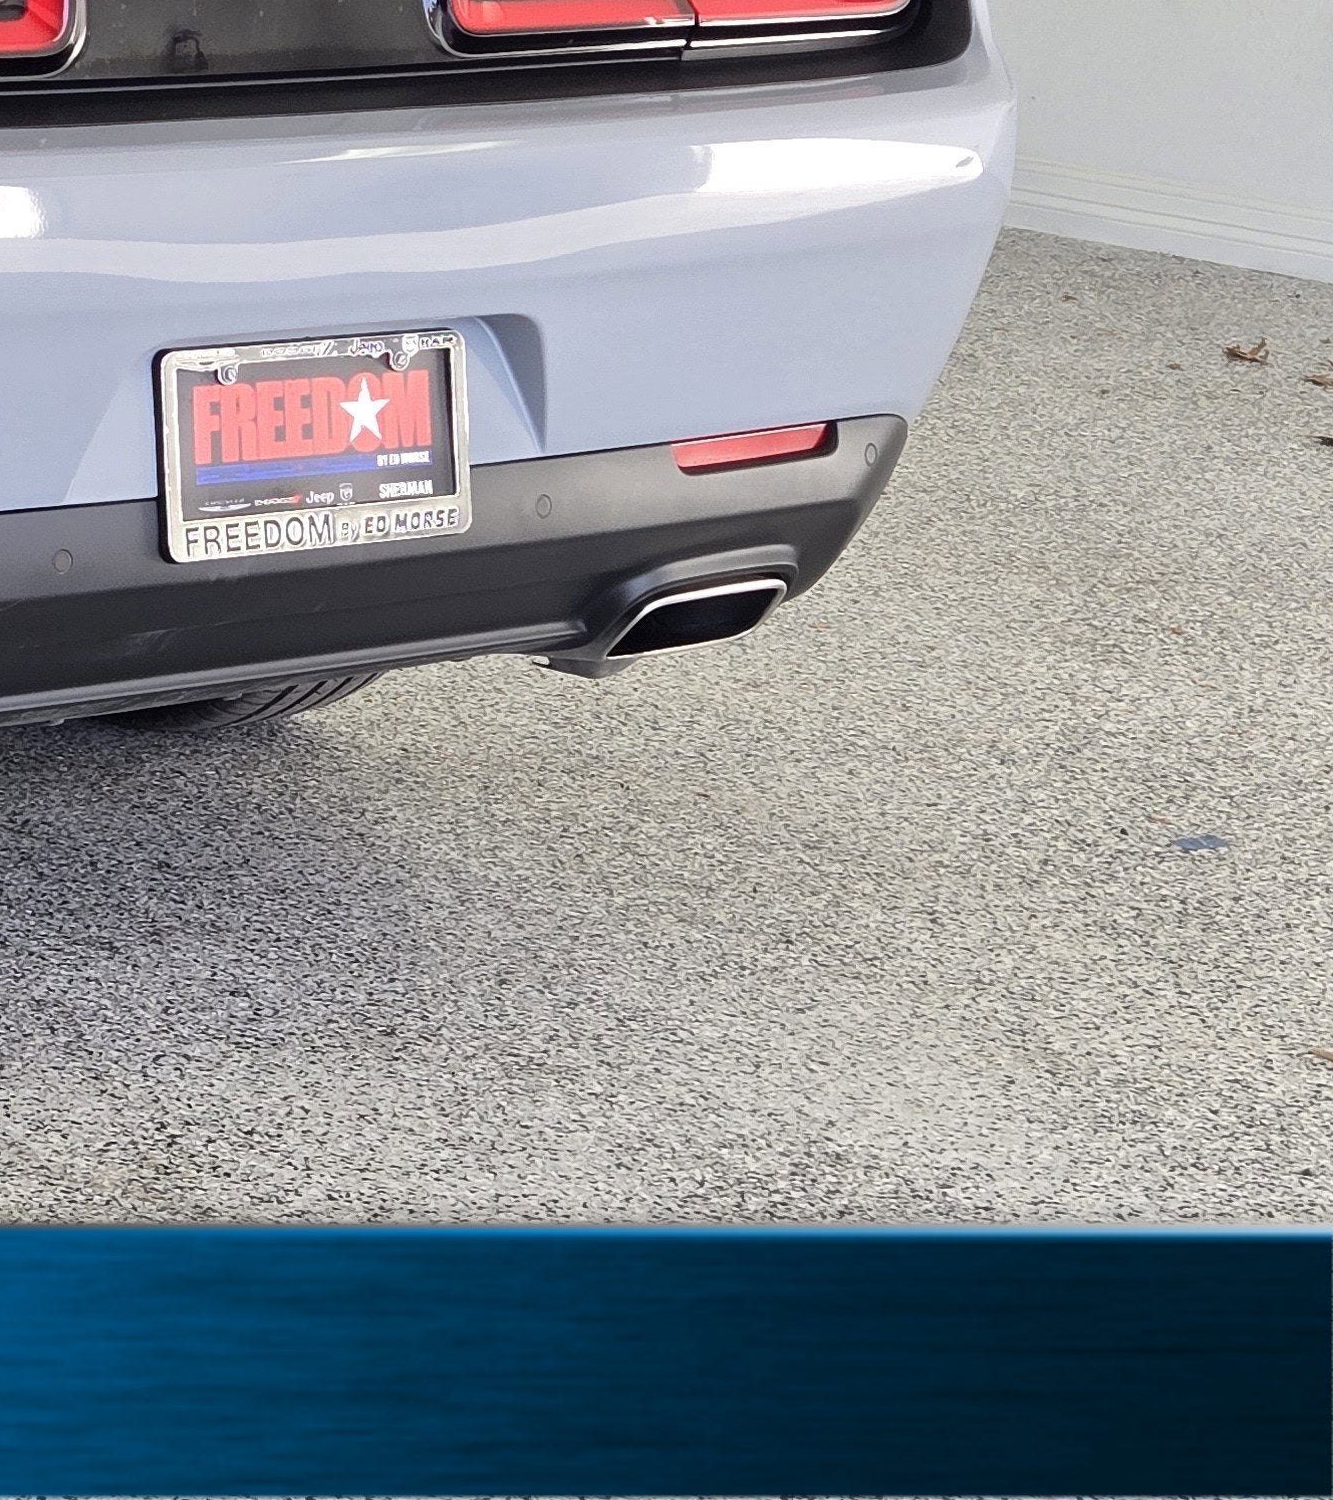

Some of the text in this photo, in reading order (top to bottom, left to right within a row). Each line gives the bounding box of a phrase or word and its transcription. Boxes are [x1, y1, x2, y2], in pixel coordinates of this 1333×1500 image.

[192, 369, 432, 465] FREEDOM
[306, 490, 335, 505] Jeep
[379, 479, 434, 499] SHERMAN
[185, 512, 333, 558] FREEDOM
[364, 515, 388, 534] ED
[394, 508, 459, 532] MORSE
